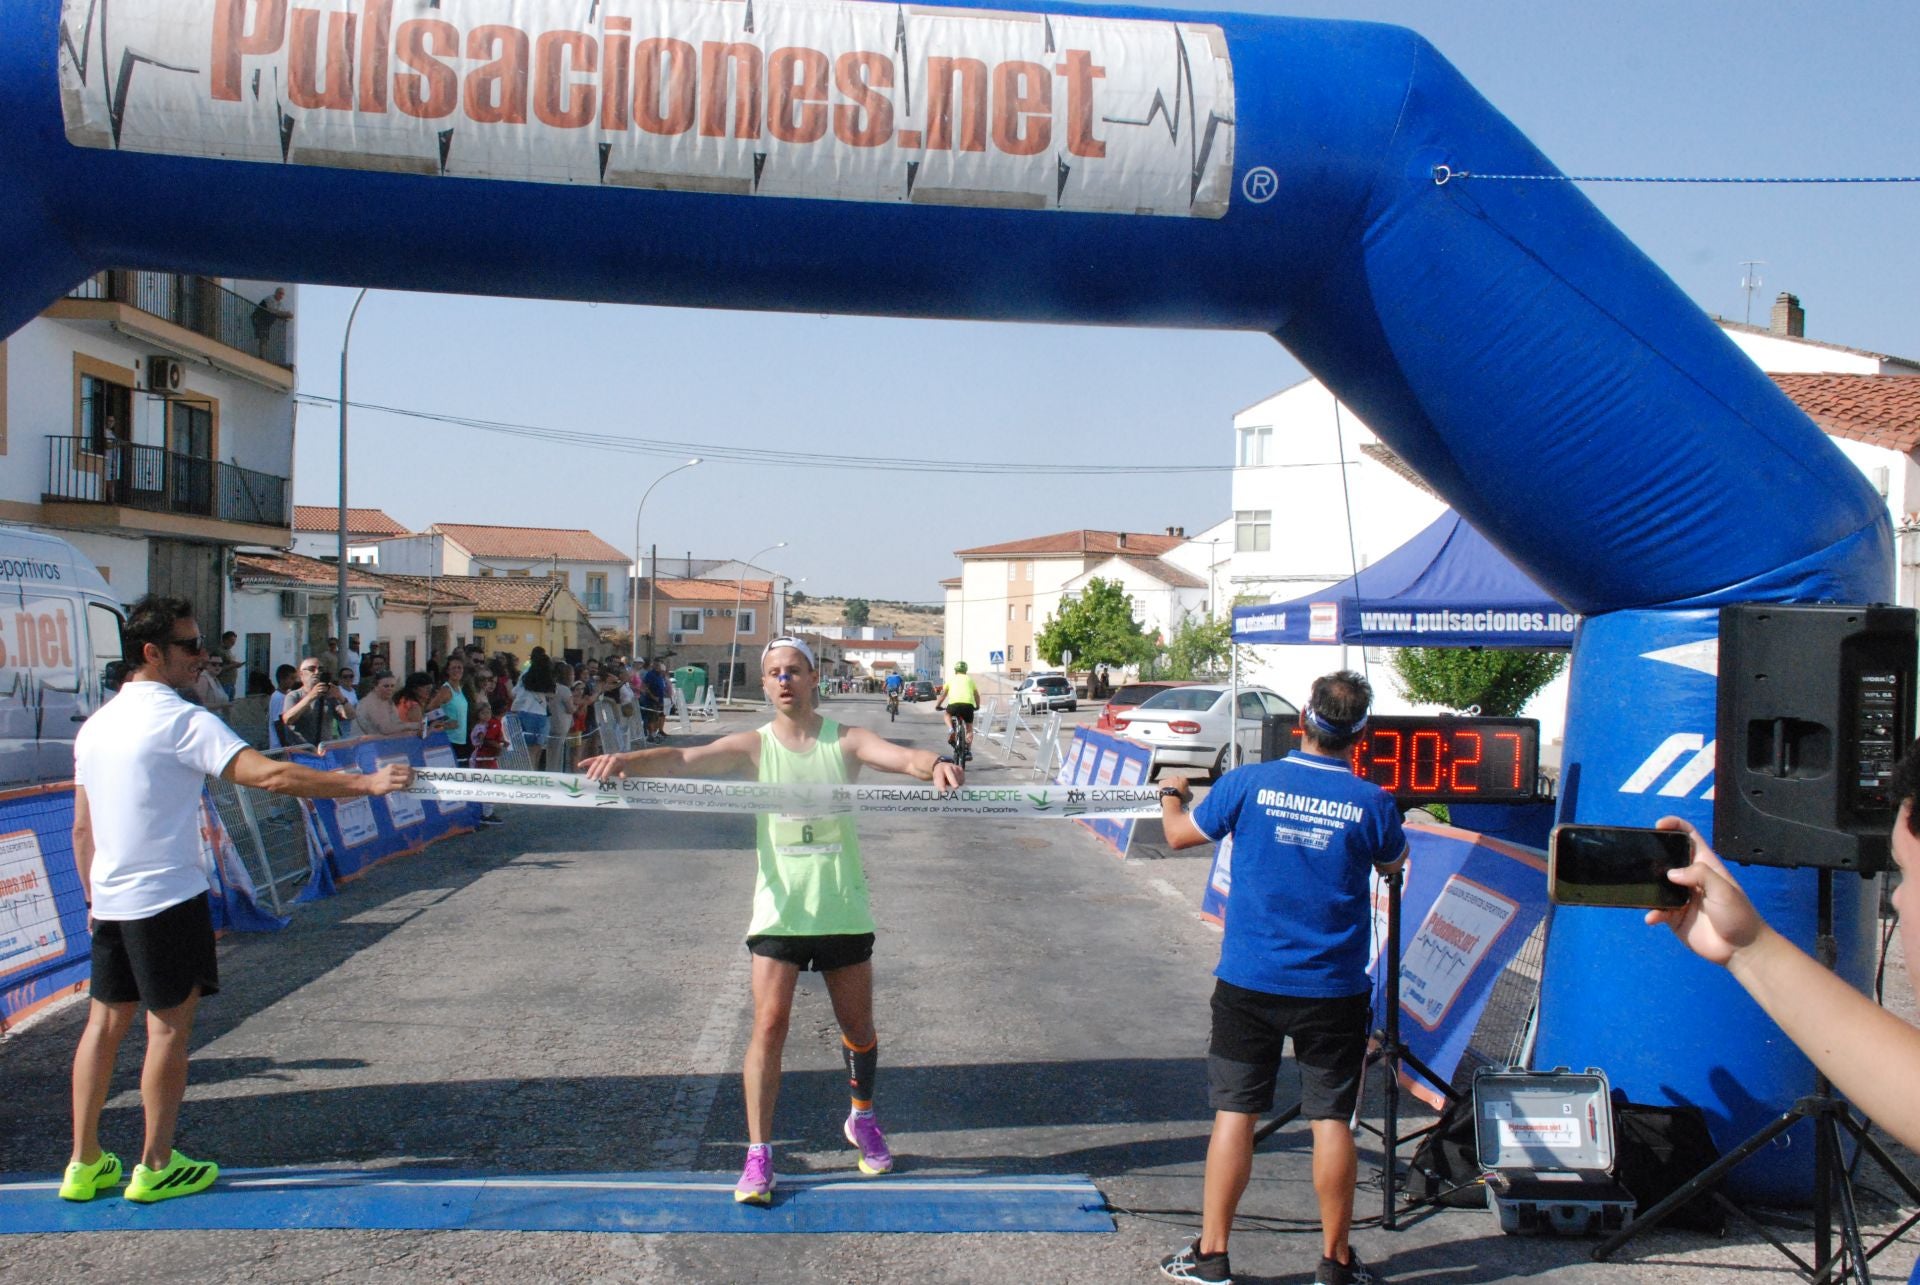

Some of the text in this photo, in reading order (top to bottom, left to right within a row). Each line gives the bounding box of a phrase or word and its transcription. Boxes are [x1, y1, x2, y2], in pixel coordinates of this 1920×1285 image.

[211, 0, 1106, 158] Pulsaciones.net
[415, 770, 555, 787] REMADURA DEPORTE
[622, 780, 786, 798] EXTREMADURA DEPORTE
[857, 789, 1022, 801] EXTREMADURA DEPORTE
[941, 805, 974, 813] Jóvenes
[982, 806, 1019, 814] Deportes
[1256, 788, 1363, 823] ORGANIZACIÓN
[1265, 808, 1345, 829] EVENTOS DEPORTIVOS
[801, 824, 814, 844] 6
